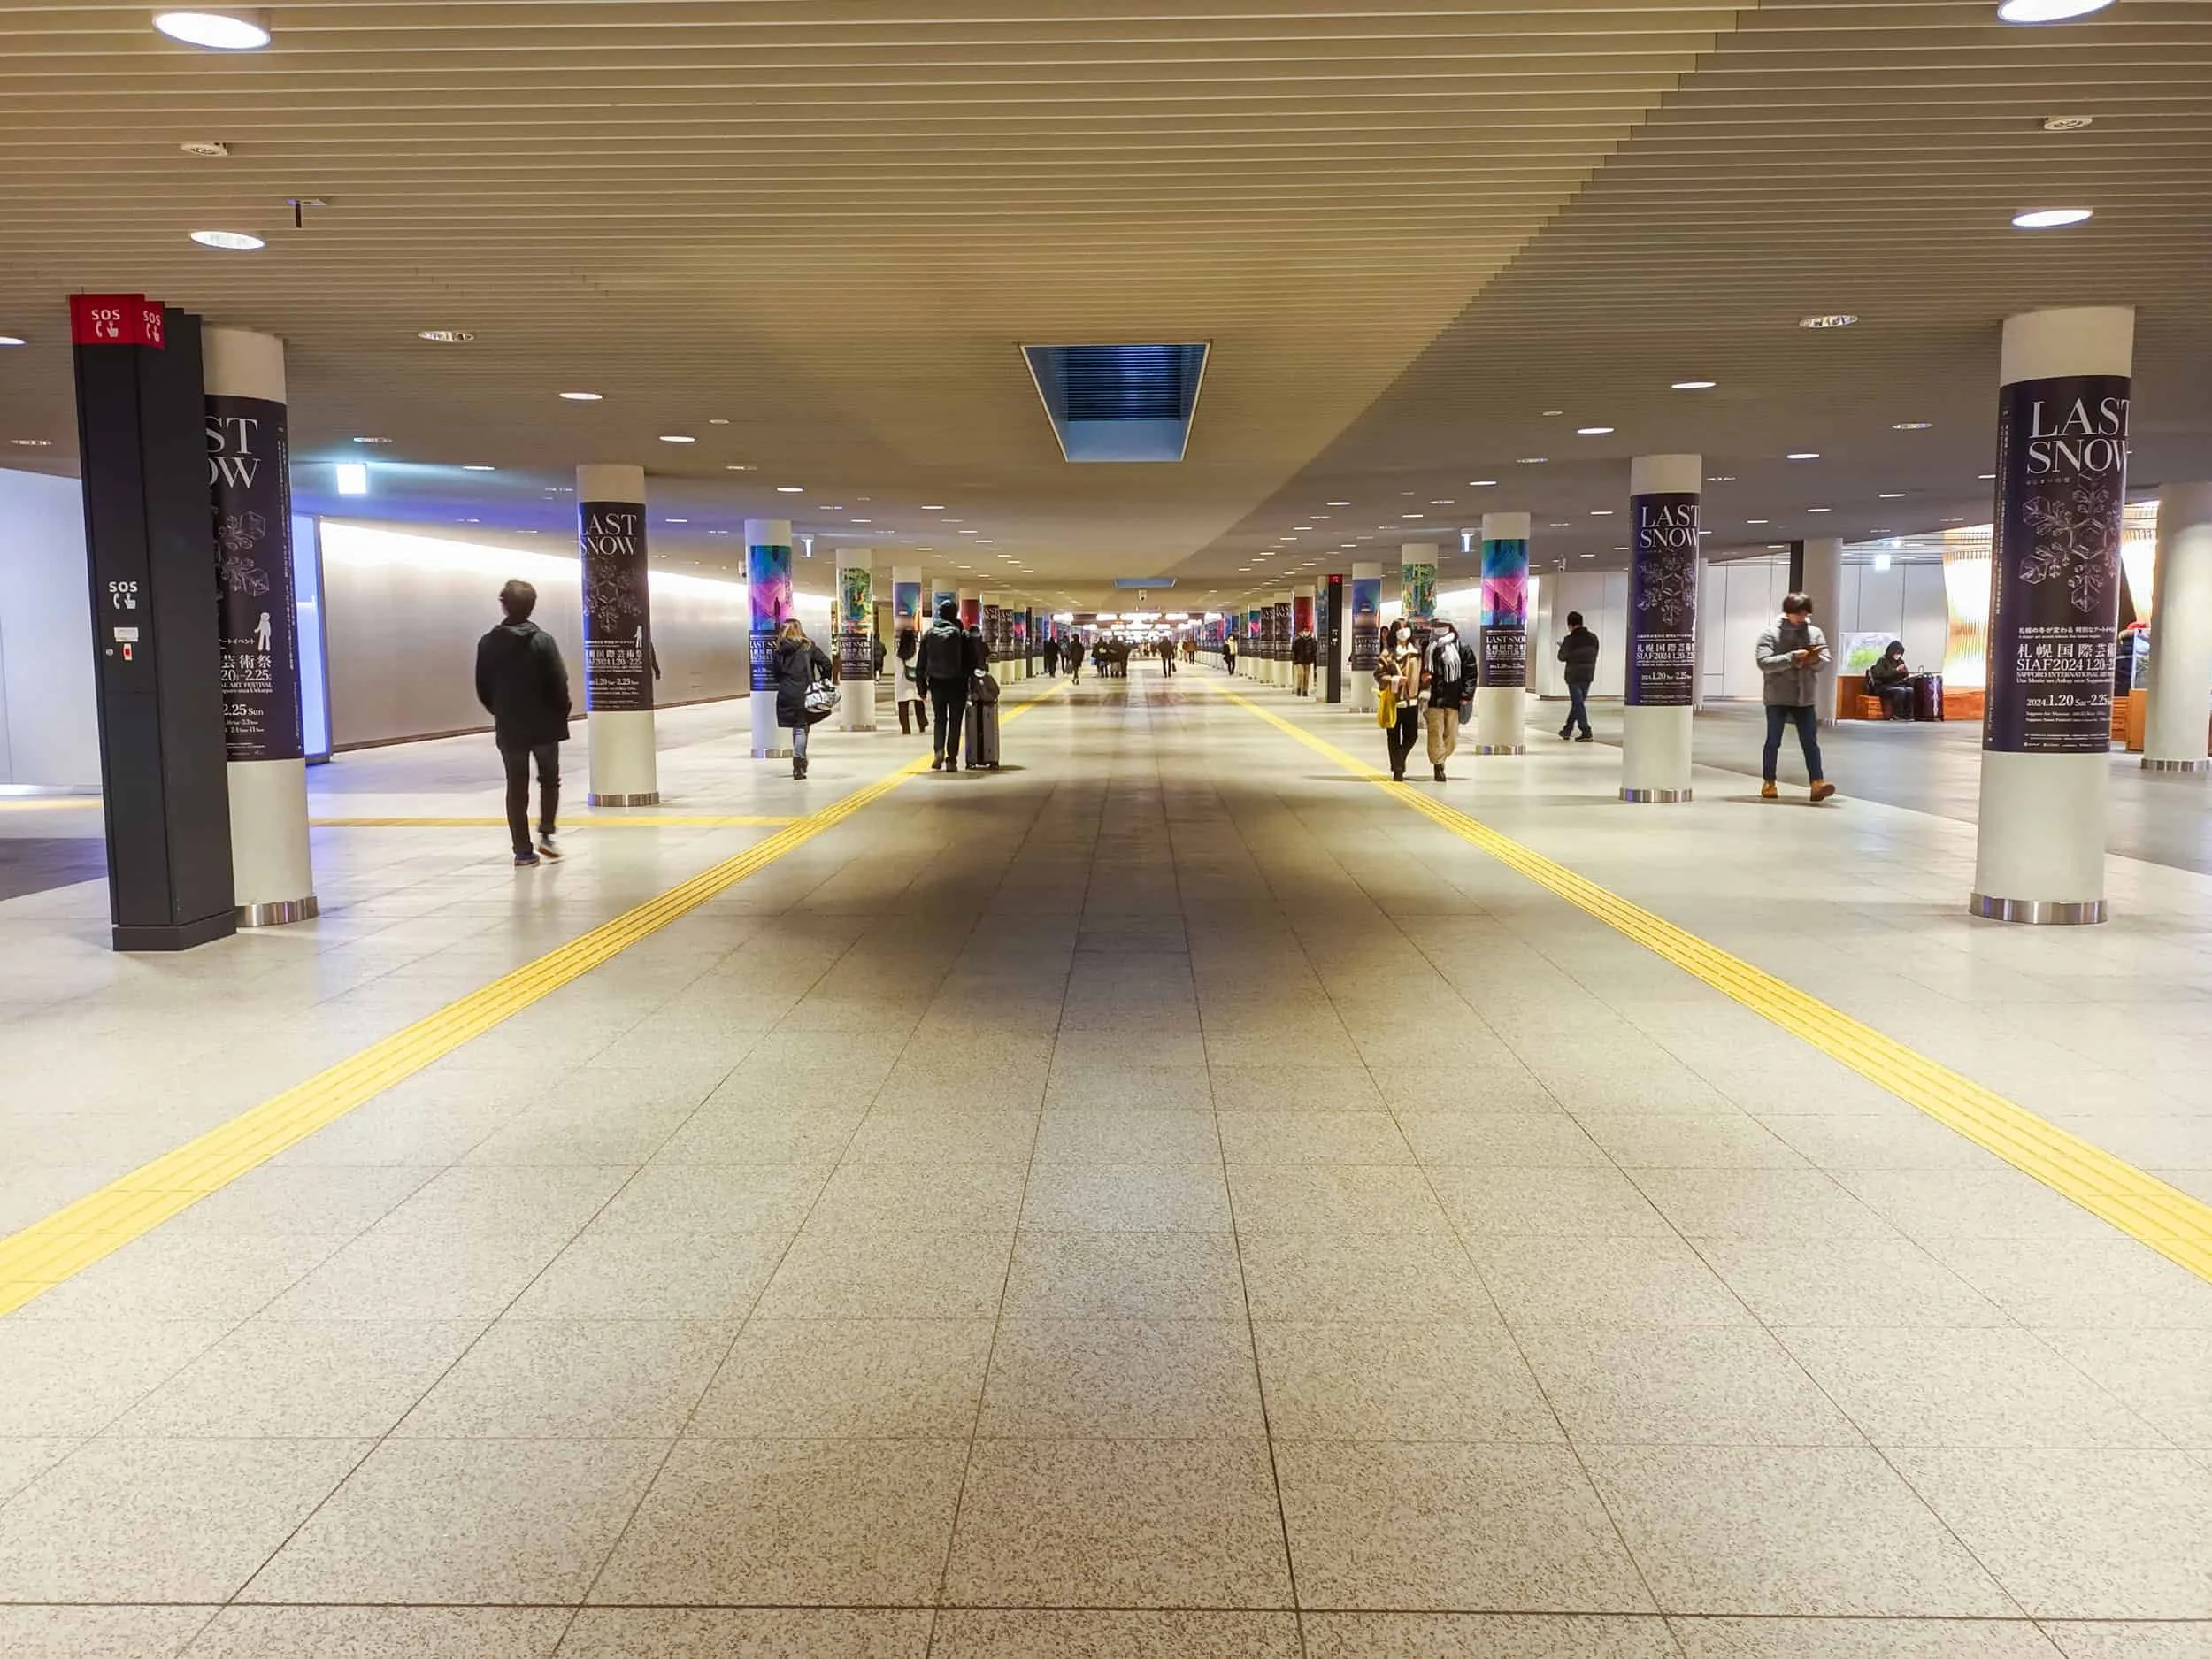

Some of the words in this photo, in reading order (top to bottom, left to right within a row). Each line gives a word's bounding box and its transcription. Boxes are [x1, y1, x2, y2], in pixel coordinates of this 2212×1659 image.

[91, 309, 120, 320] SOS
[143, 311, 161, 326] SOS
[1642, 504, 1699, 527] LAST
[109, 581, 138, 592] SOS
[2017, 658, 2084, 671] SIAF2024
